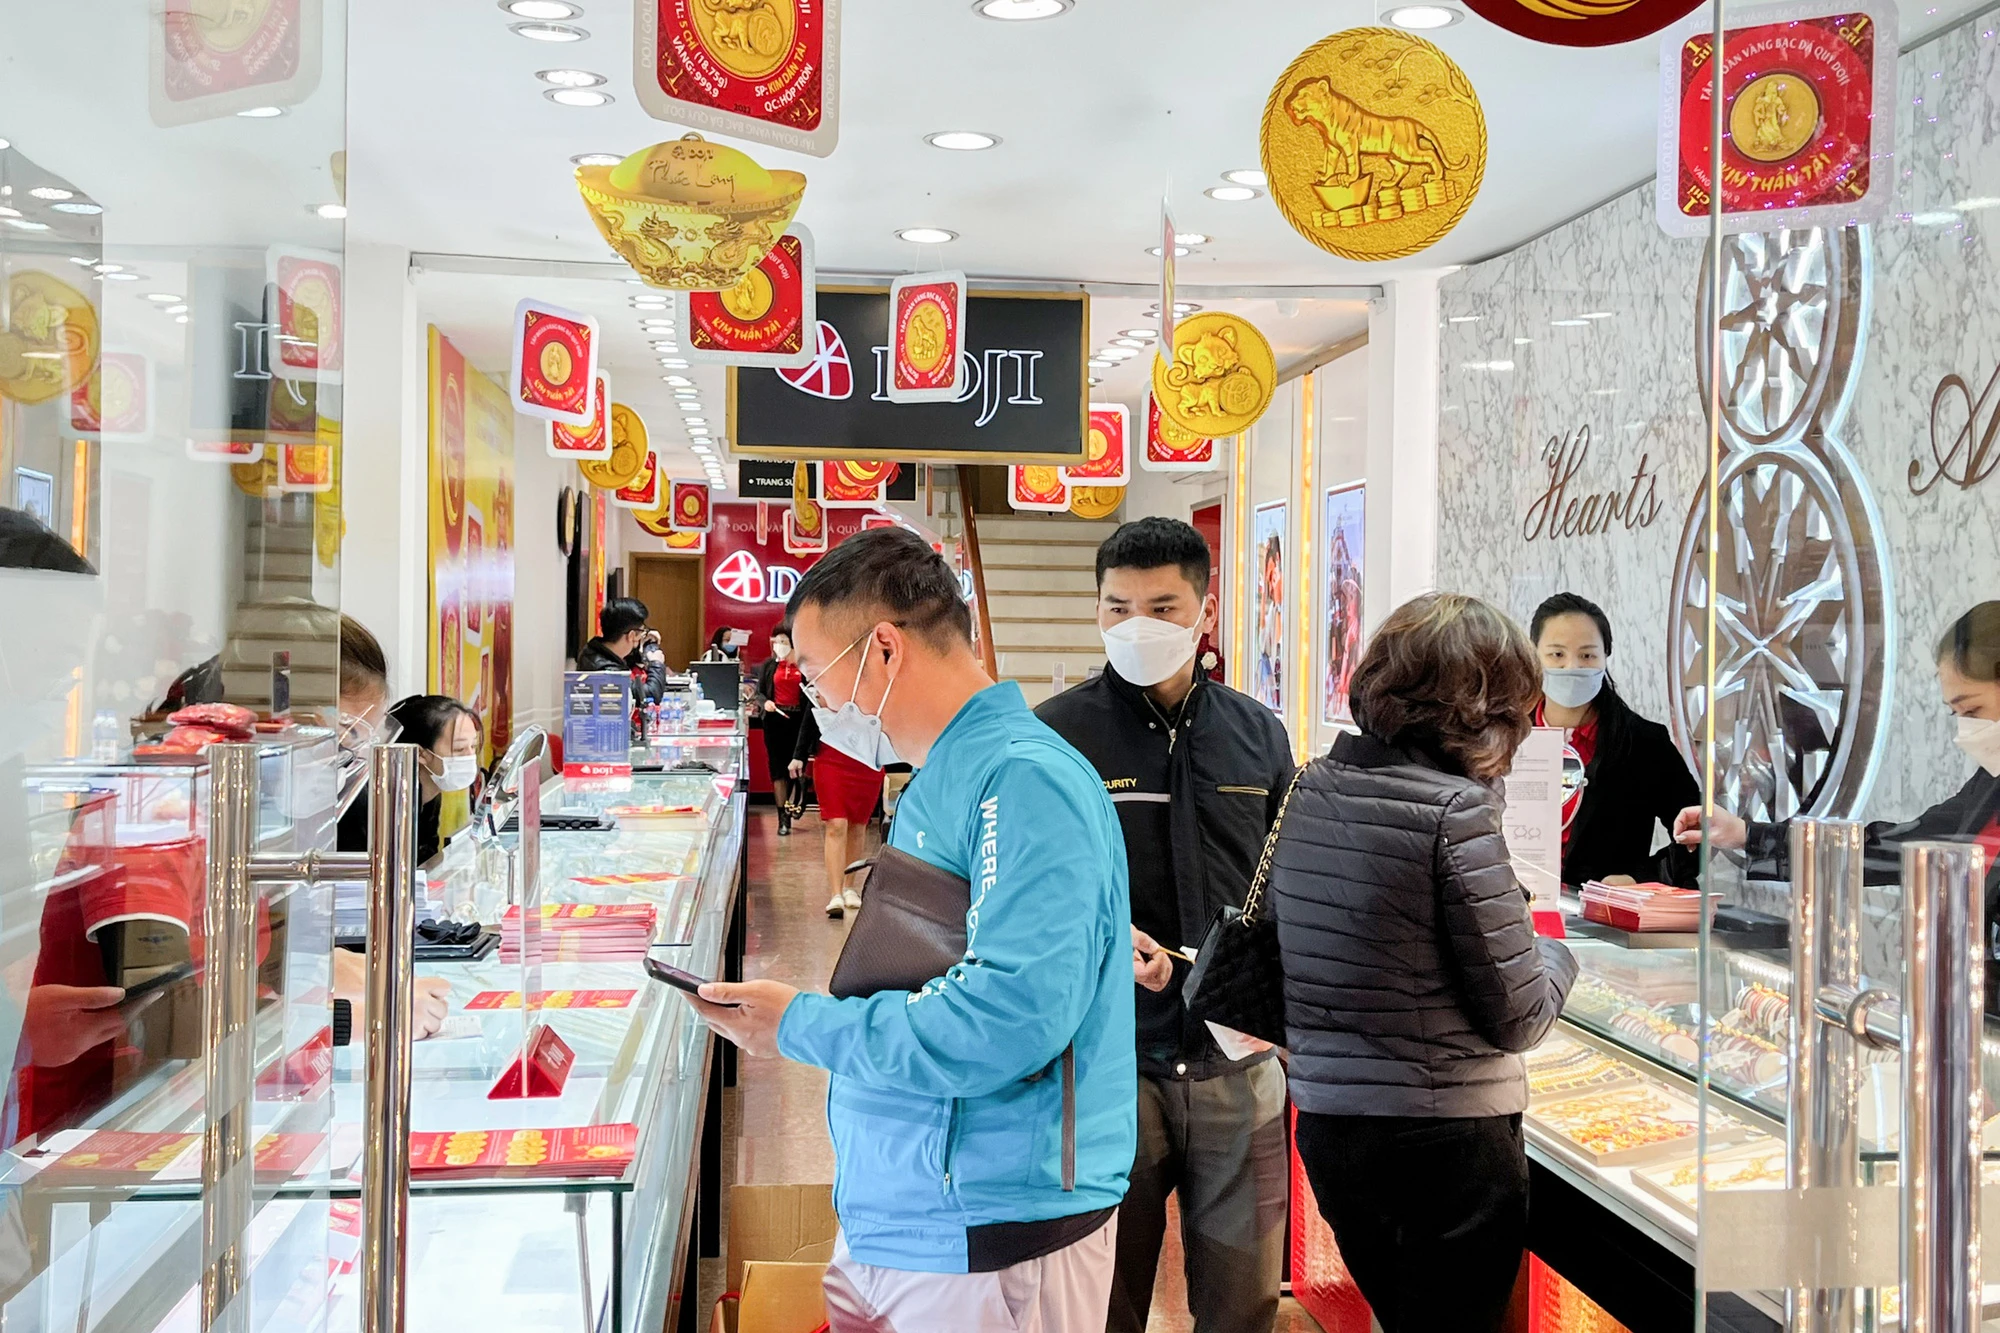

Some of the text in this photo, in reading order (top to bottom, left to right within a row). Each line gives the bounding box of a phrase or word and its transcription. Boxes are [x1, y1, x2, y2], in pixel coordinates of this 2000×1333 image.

[1722, 54, 1742, 75] OÀN
[711, 316, 733, 336] KIM
[756, 477, 784, 487] TRANG
[1524, 424, 1662, 542] Hearts
[732, 521, 757, 532] ĐOÀ
[766, 521, 784, 533] VÀN
[591, 766, 614, 776] DOJI
[1102, 777, 1137, 790] CURITY
